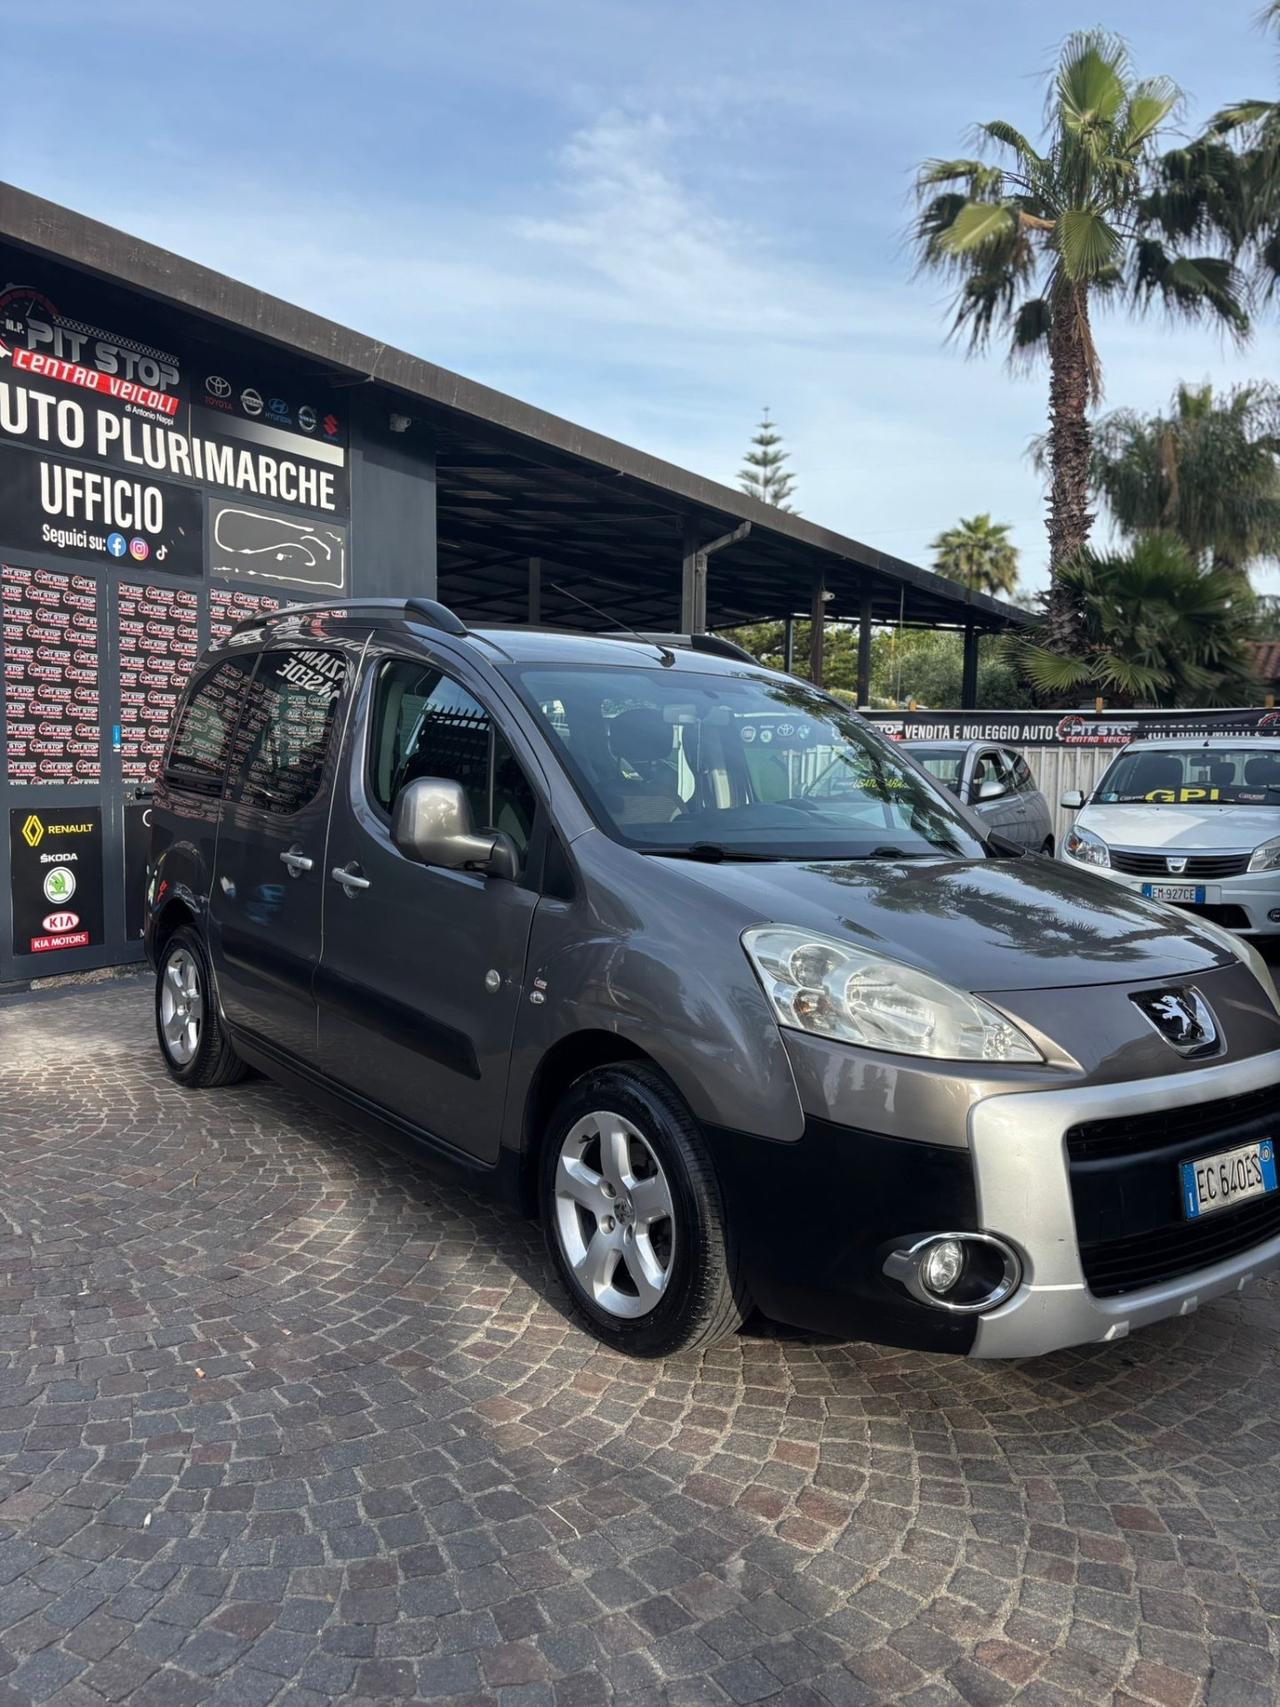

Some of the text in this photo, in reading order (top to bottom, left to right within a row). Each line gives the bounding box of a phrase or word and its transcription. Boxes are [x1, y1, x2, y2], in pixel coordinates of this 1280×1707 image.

[26, 317, 180, 391] PIT STOP
[204, 396, 233, 411] TOYOTA
[125, 404, 174, 426] di Antonio Nappi
[97, 409, 335, 510] PLURIMARCHE
[40, 461, 163, 533] UFFICIO
[42, 523, 106, 551] Seguici su:
[905, 725, 1053, 740] VENDITA E NOLEGGIO AUTO
[1072, 725, 1096, 735] PIT
[48, 823, 93, 834] RENAULT
[40, 853, 78, 863] ŠKODA
[49, 916, 73, 928] KIA
[34, 934, 85, 949] KIA MOTORS
[1196, 1153, 1262, 1203] EC 640ES
